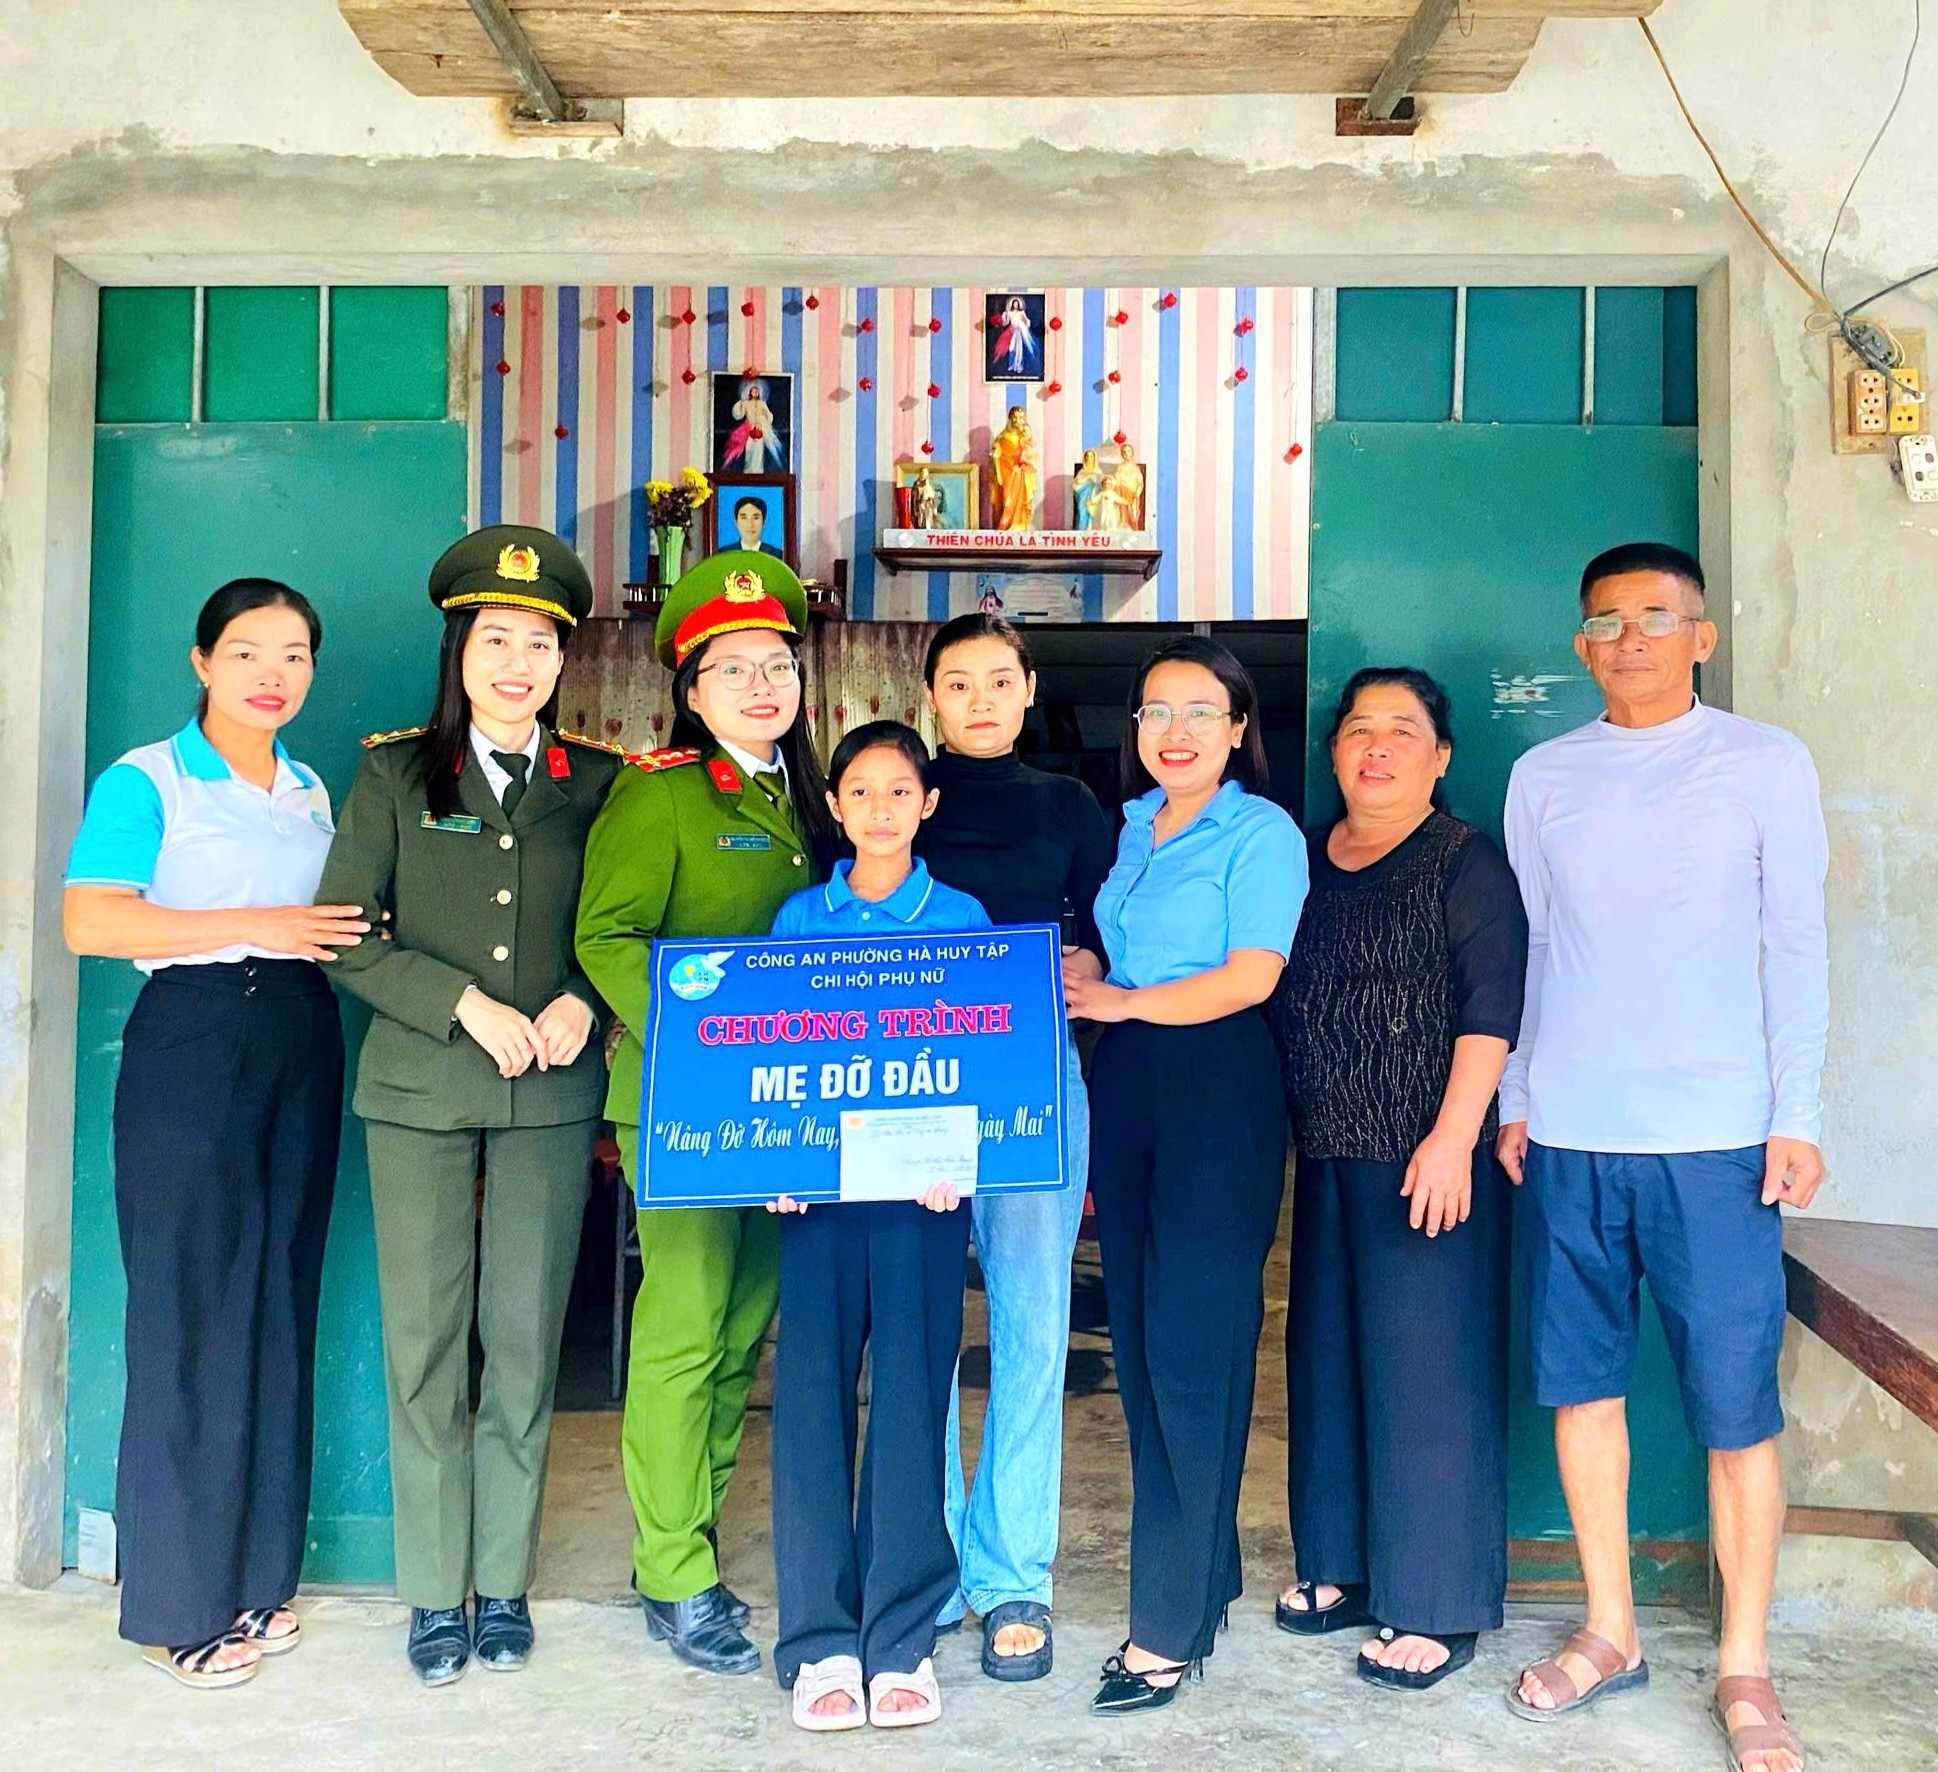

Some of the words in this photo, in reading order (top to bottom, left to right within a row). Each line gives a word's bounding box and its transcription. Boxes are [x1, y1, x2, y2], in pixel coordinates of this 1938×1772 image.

[1042, 531, 1077, 546] TÌNH
[1082, 531, 1111, 547] YÊU
[746, 952, 795, 968] CÔNG
[800, 953, 826, 966] AN
[831, 947, 902, 964] PHƯỜNG
[908, 945, 931, 961] HÀ
[936, 946, 971, 960] HUY
[976, 942, 1009, 960] TẬP
[811, 975, 841, 988] CHI
[845, 970, 873, 989] HỘI
[879, 971, 915, 986] PHỤ
[920, 967, 945, 984] NỮ
[698, 1009, 869, 1045] CHƯƠNG
[878, 999, 1012, 1037] TRÌNH
[751, 1065, 808, 1109] MẸ
[819, 1054, 873, 1099] ĐỠ
[882, 1047, 960, 1097] ĐẦU
[751, 1117, 792, 1148] Hôm
[797, 1115, 840, 1152] Nay,
